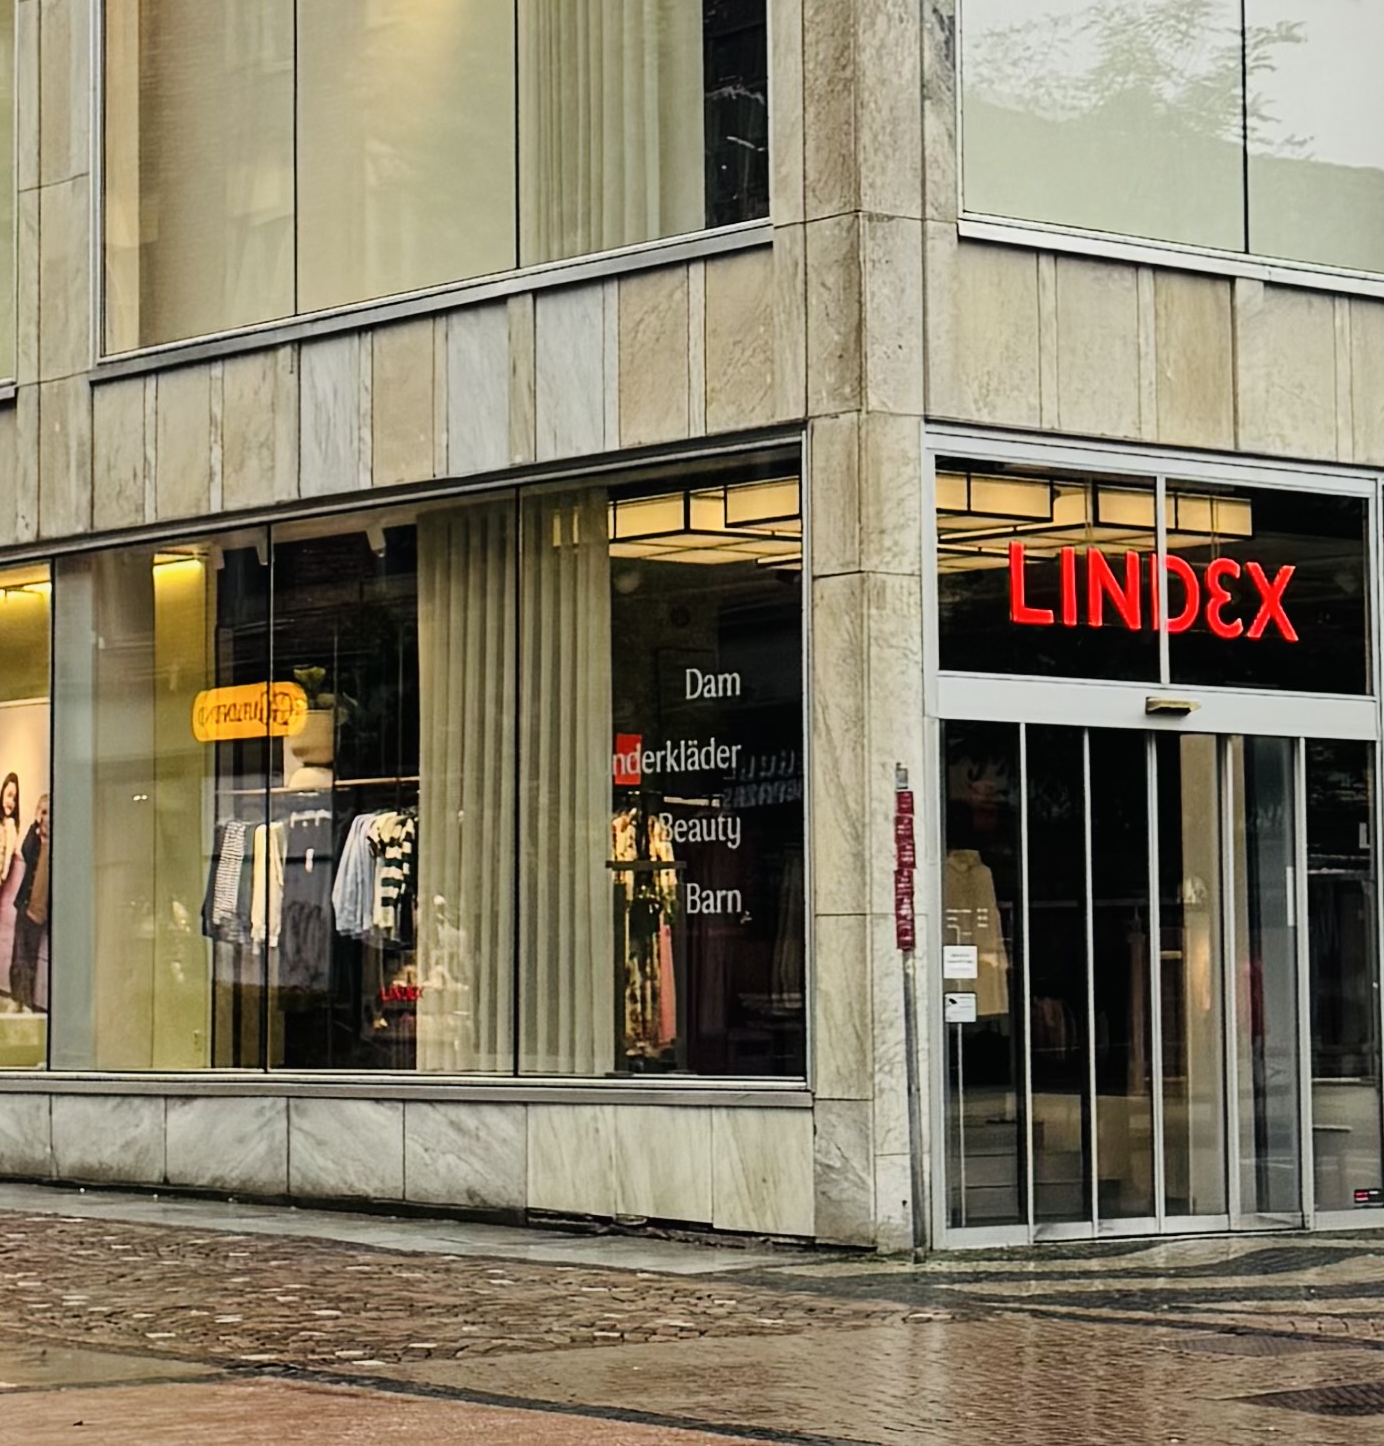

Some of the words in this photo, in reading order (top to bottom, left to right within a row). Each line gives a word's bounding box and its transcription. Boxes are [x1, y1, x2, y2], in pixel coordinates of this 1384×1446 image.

[1009, 541, 1299, 641] LINDEX
[685, 668, 741, 700] Dam
[658, 811, 741, 849] Beauty
[685, 882, 742, 914] Barn
